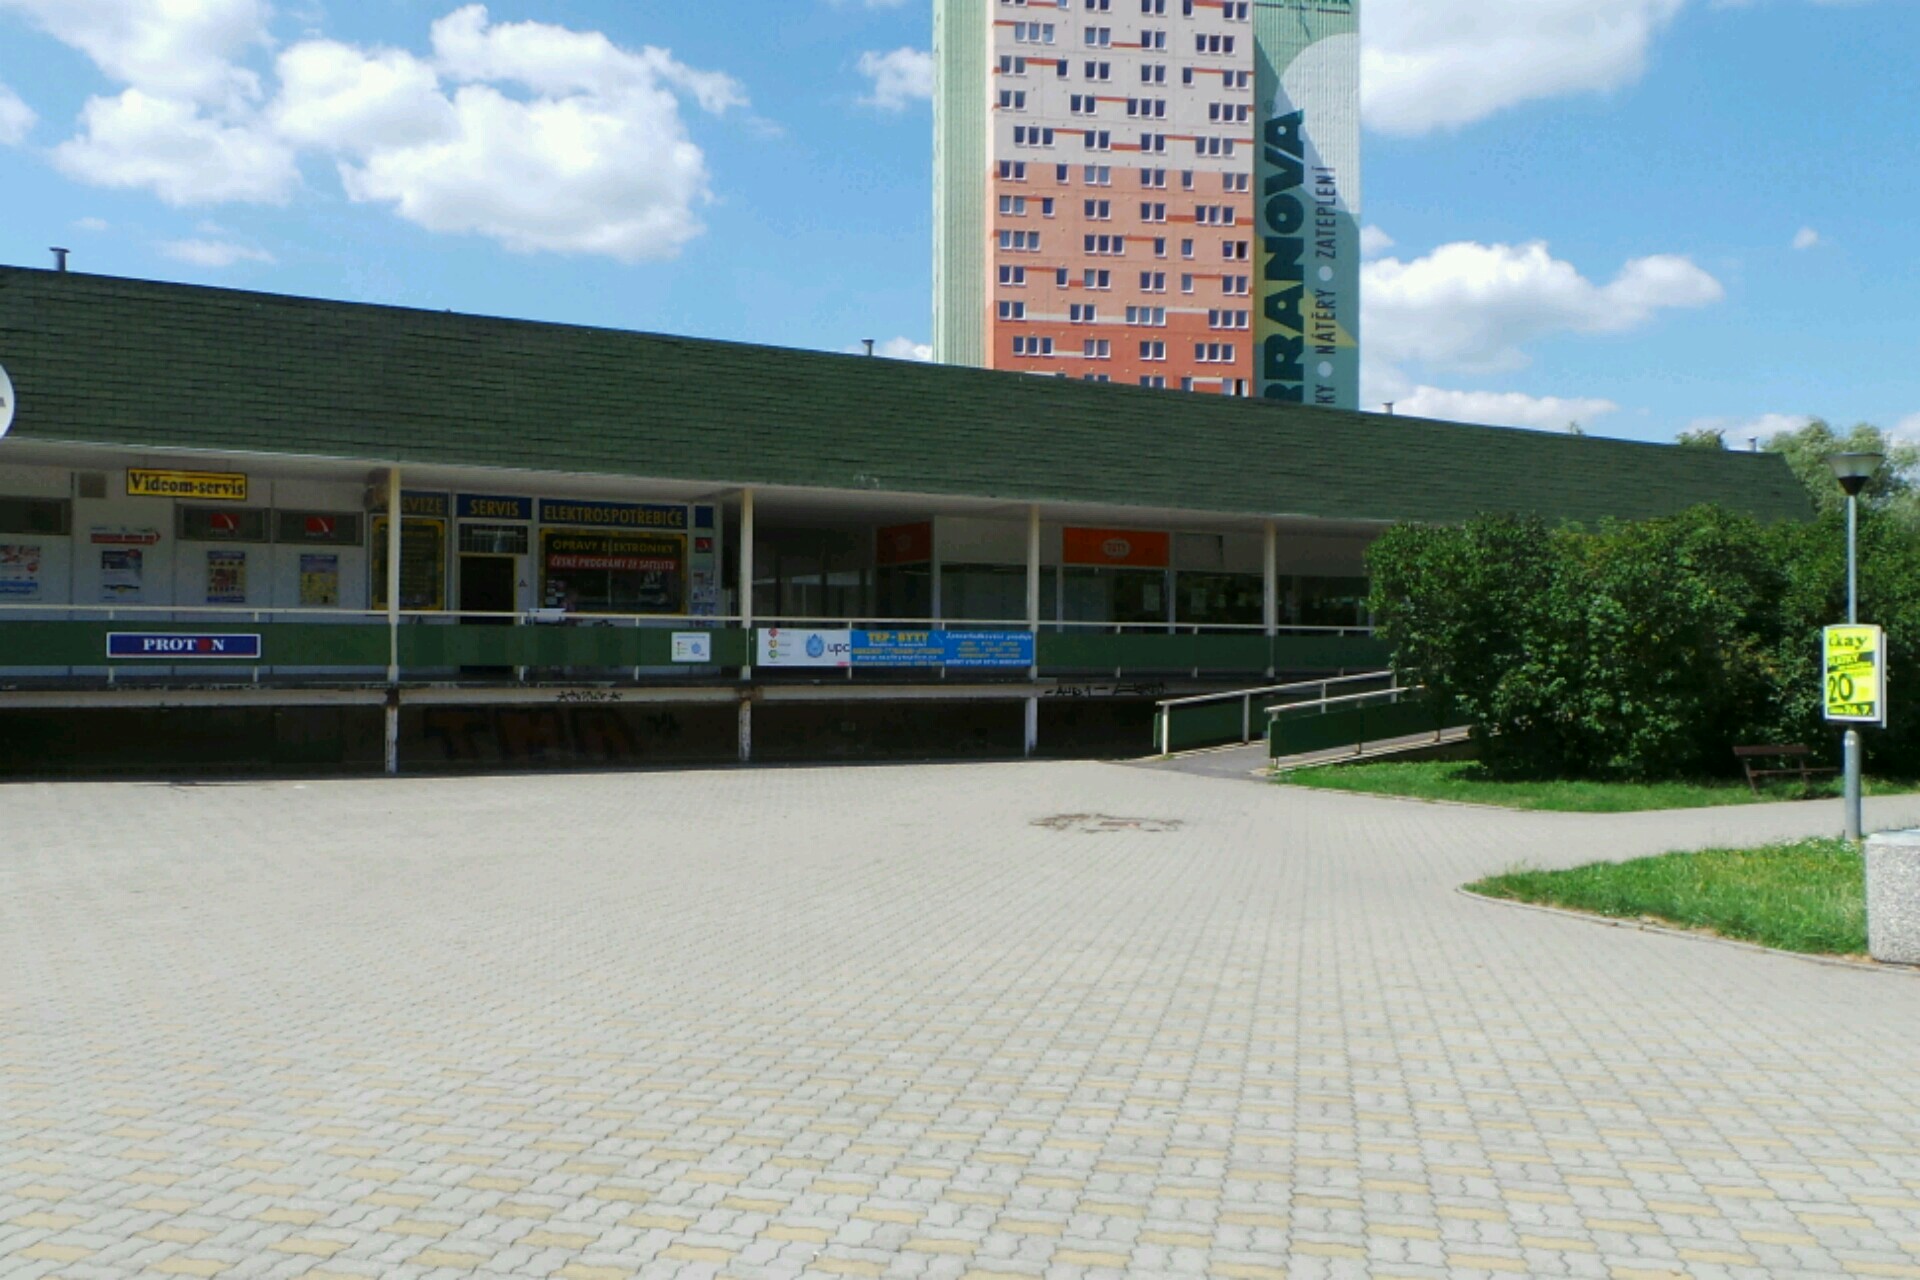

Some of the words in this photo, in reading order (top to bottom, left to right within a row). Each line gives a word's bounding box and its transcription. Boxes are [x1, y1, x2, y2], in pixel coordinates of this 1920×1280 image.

[1311, 165, 1336, 259] ZATEPLENÍ
[129, 471, 244, 496] Vidcom-servis
[470, 501, 519, 516] SERVIS
[544, 504, 683, 526] ELEKTROSPOTŘEBIČE
[827, 643, 850, 656] upc
[1828, 673, 1853, 703] 20
